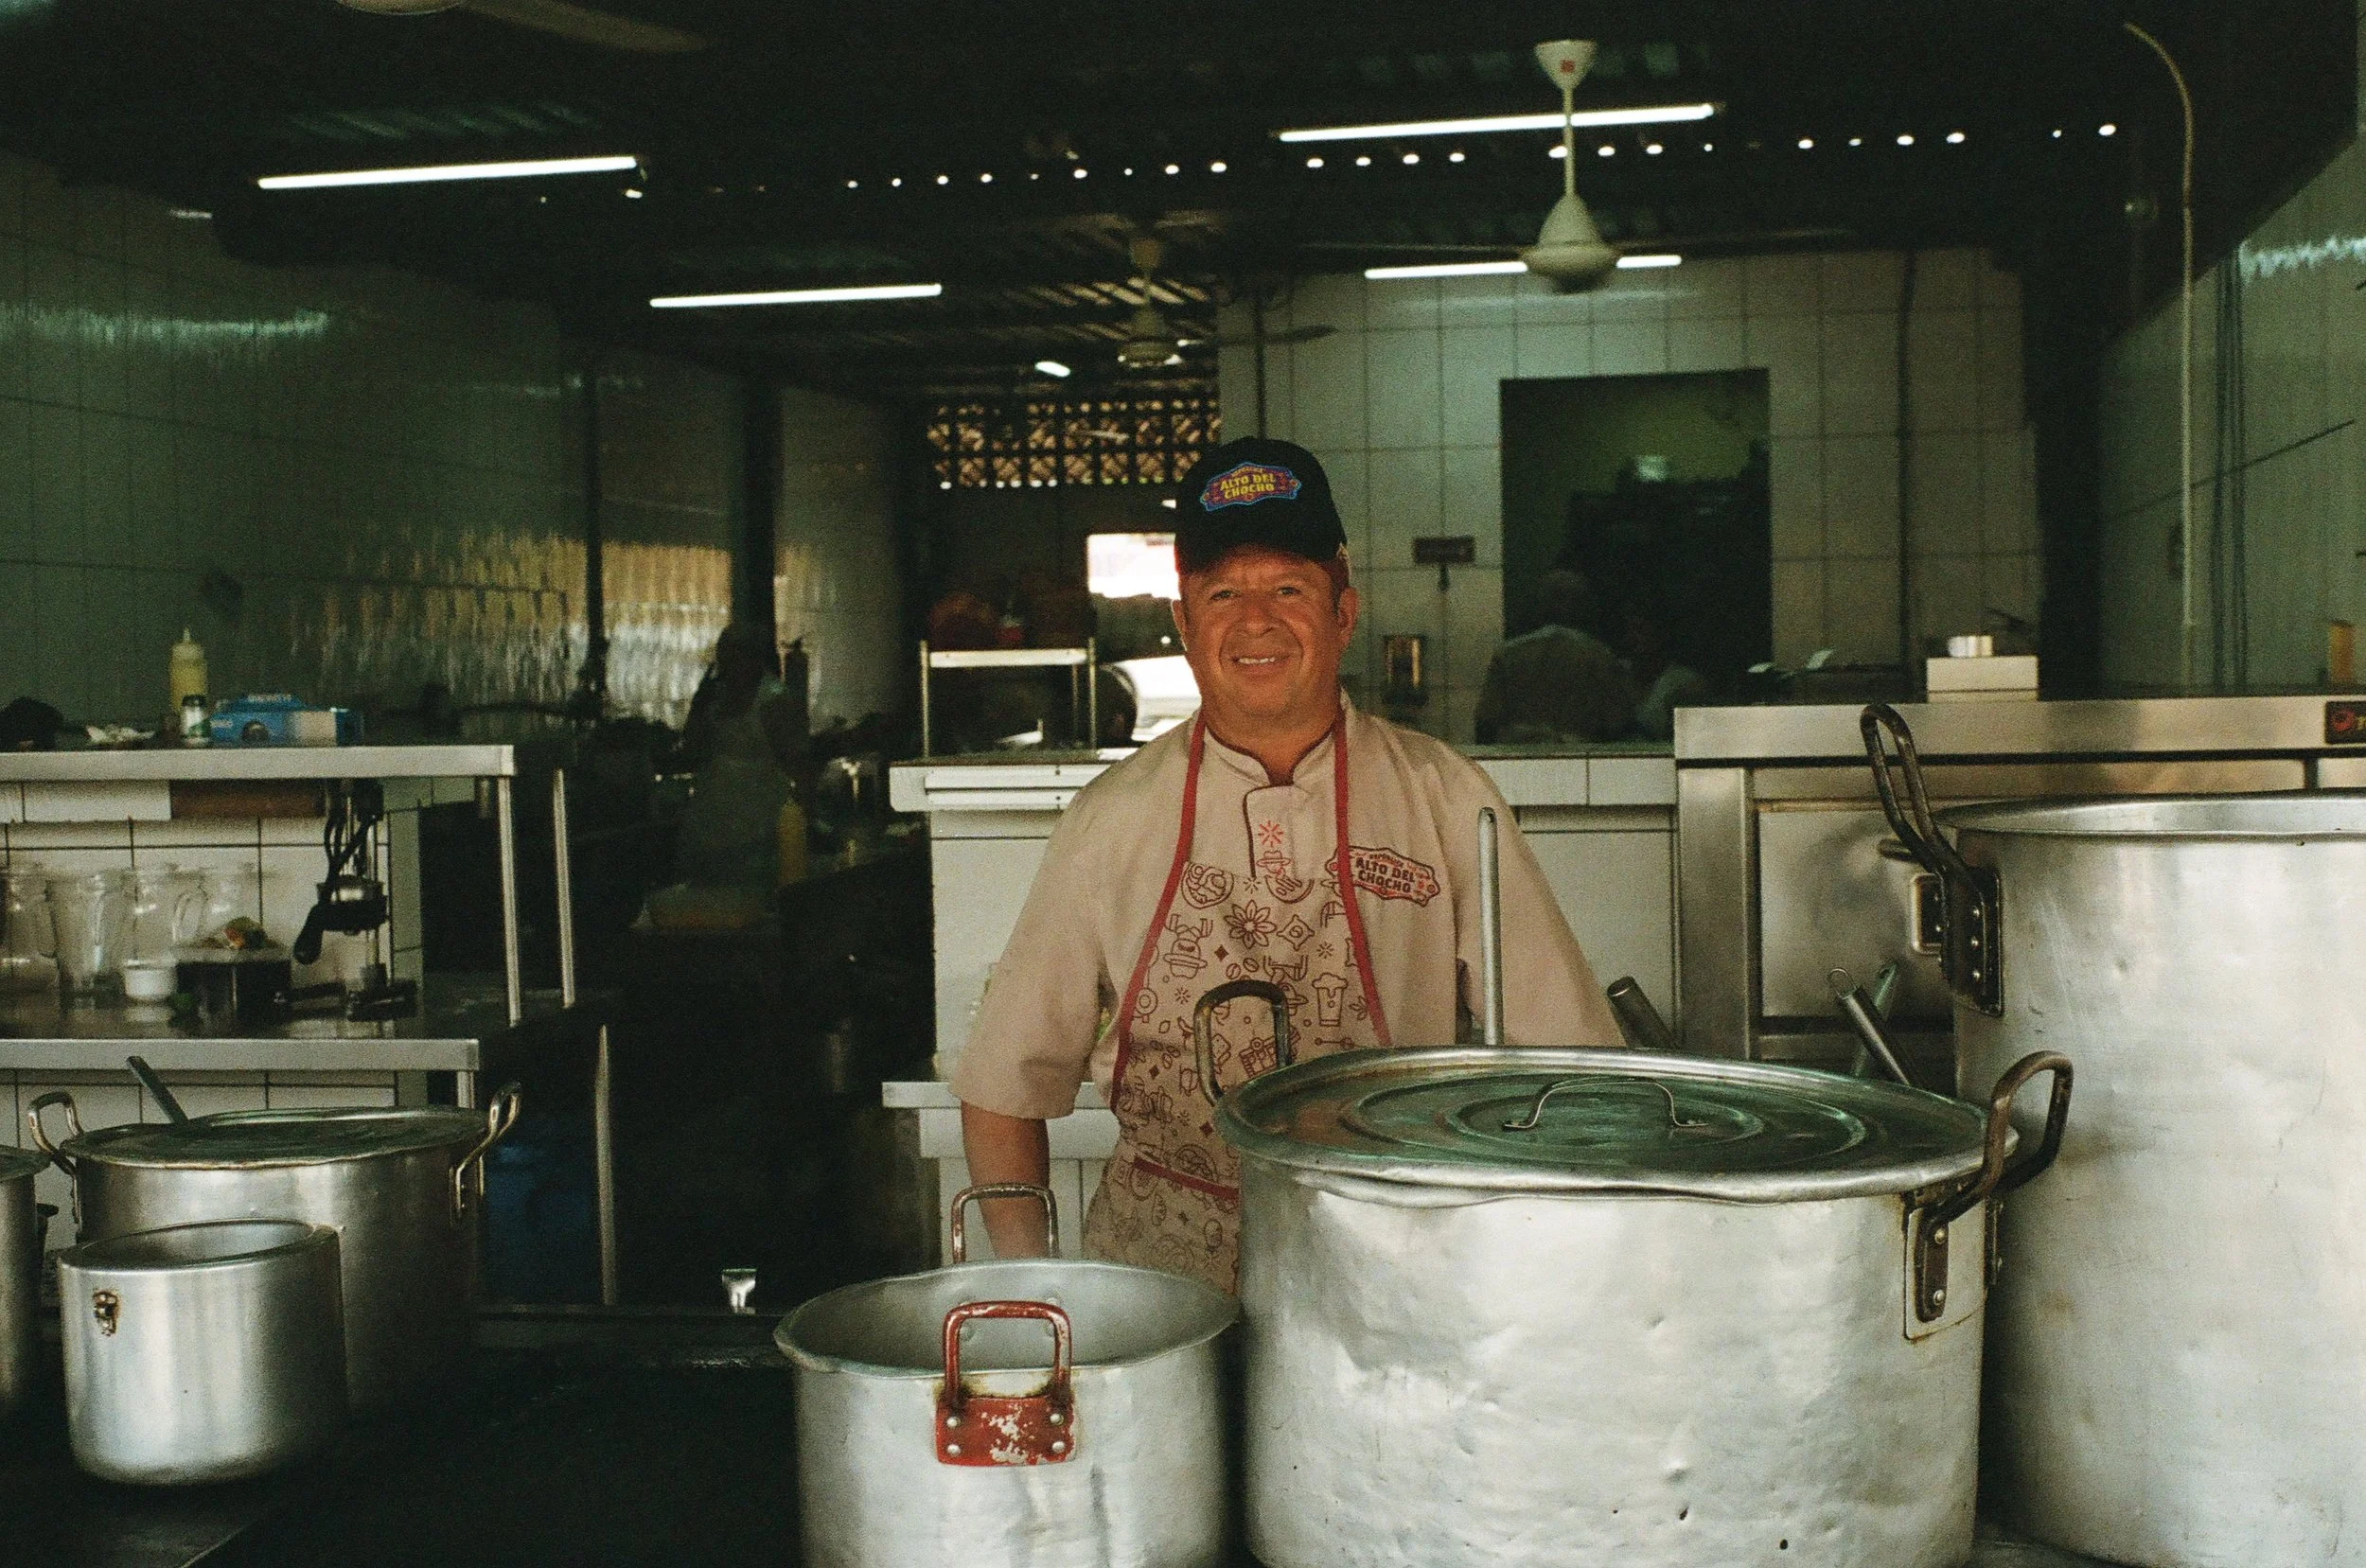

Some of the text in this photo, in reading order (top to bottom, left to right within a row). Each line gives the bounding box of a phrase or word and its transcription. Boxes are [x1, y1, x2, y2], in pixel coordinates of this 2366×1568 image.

[1220, 472, 1277, 491] ALTO DEL
[1224, 483, 1275, 500] CHOCHO
[1355, 856, 1416, 882] ALTO DEL
[1358, 870, 1411, 892] CHOCHO
